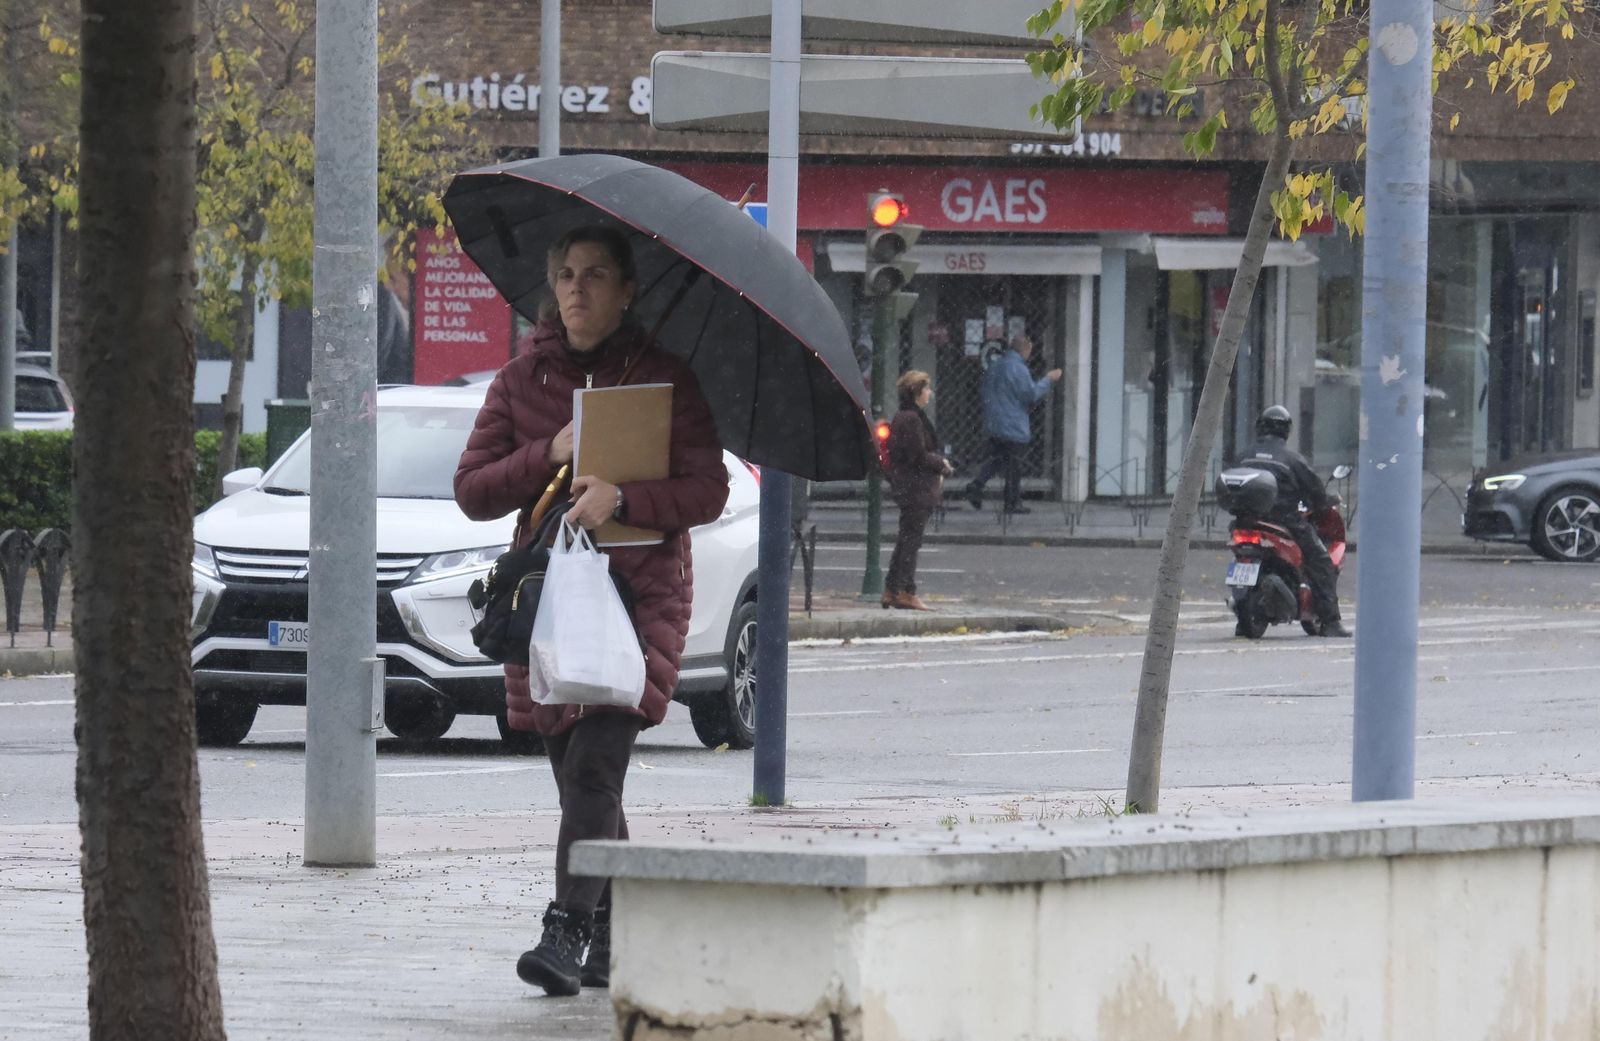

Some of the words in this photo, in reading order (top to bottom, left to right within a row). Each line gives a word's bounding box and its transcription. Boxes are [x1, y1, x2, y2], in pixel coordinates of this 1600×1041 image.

[410, 72, 609, 112] Gutiérez
[629, 76, 650, 115] &
[1089, 132, 1121, 156] 904
[941, 178, 1047, 223] GAES
[425, 255, 460, 268] AÑOS
[945, 252, 986, 271] GAES
[424, 286, 441, 298] LA
[444, 286, 497, 299] CALIDAD
[424, 301, 440, 312] DE
[443, 302, 471, 312] VIDA
[424, 315, 440, 327] DE
[443, 316, 466, 328] LAS
[424, 330, 488, 342] PERSONAS.
